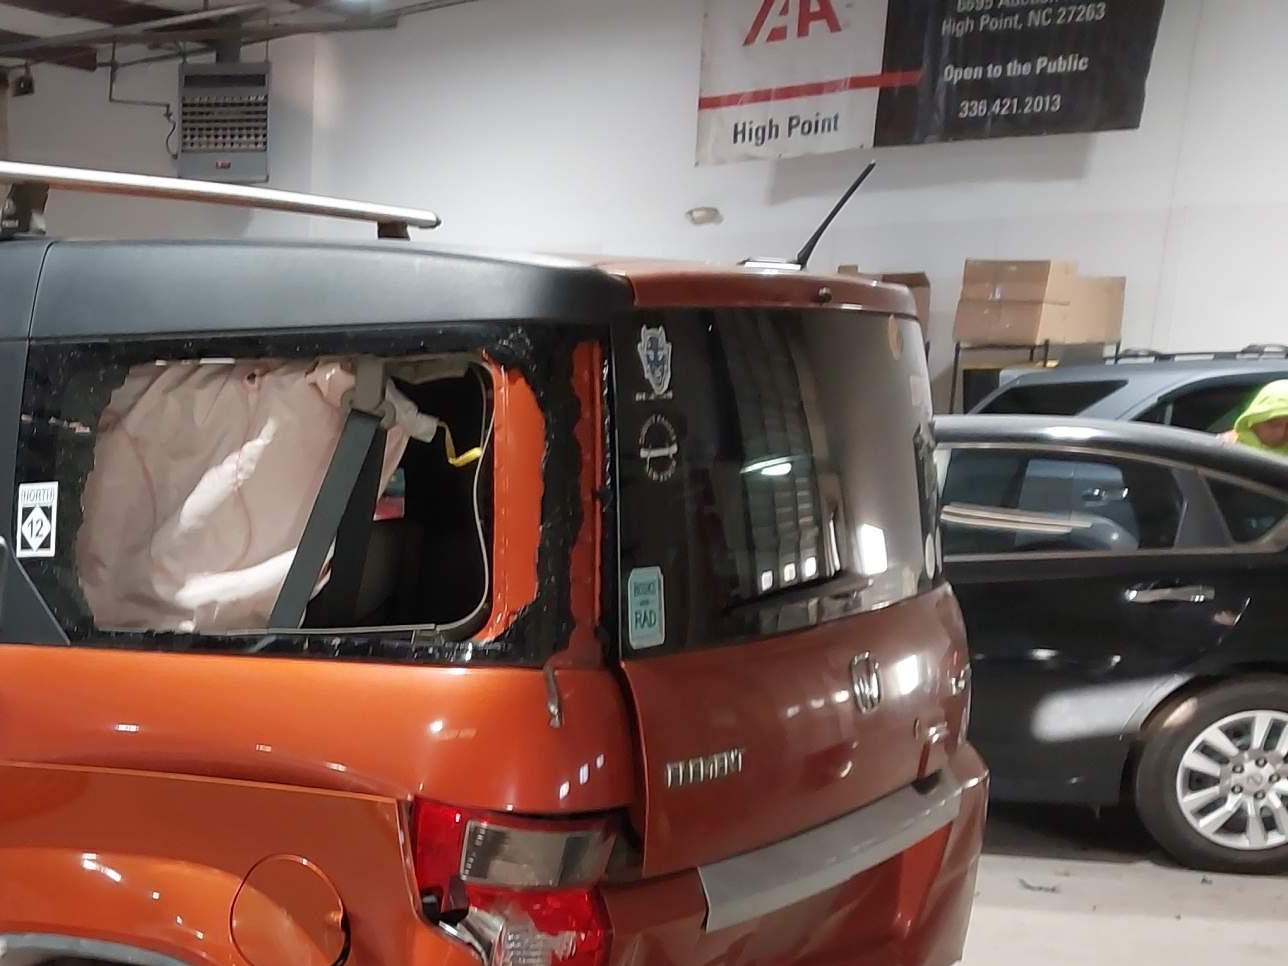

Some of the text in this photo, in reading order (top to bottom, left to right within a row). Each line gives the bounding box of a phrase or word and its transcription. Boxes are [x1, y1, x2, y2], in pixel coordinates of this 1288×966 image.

[941, 15, 975, 38] High
[979, 14, 1023, 32] Point,
[1027, 7, 1053, 27] NC
[944, 53, 1089, 85] Open to the Public
[958, 94, 1062, 118] 336.421.2013
[732, 112, 840, 147] High Point
[26, 517, 44, 539] 12
[634, 609, 657, 630] RAD
